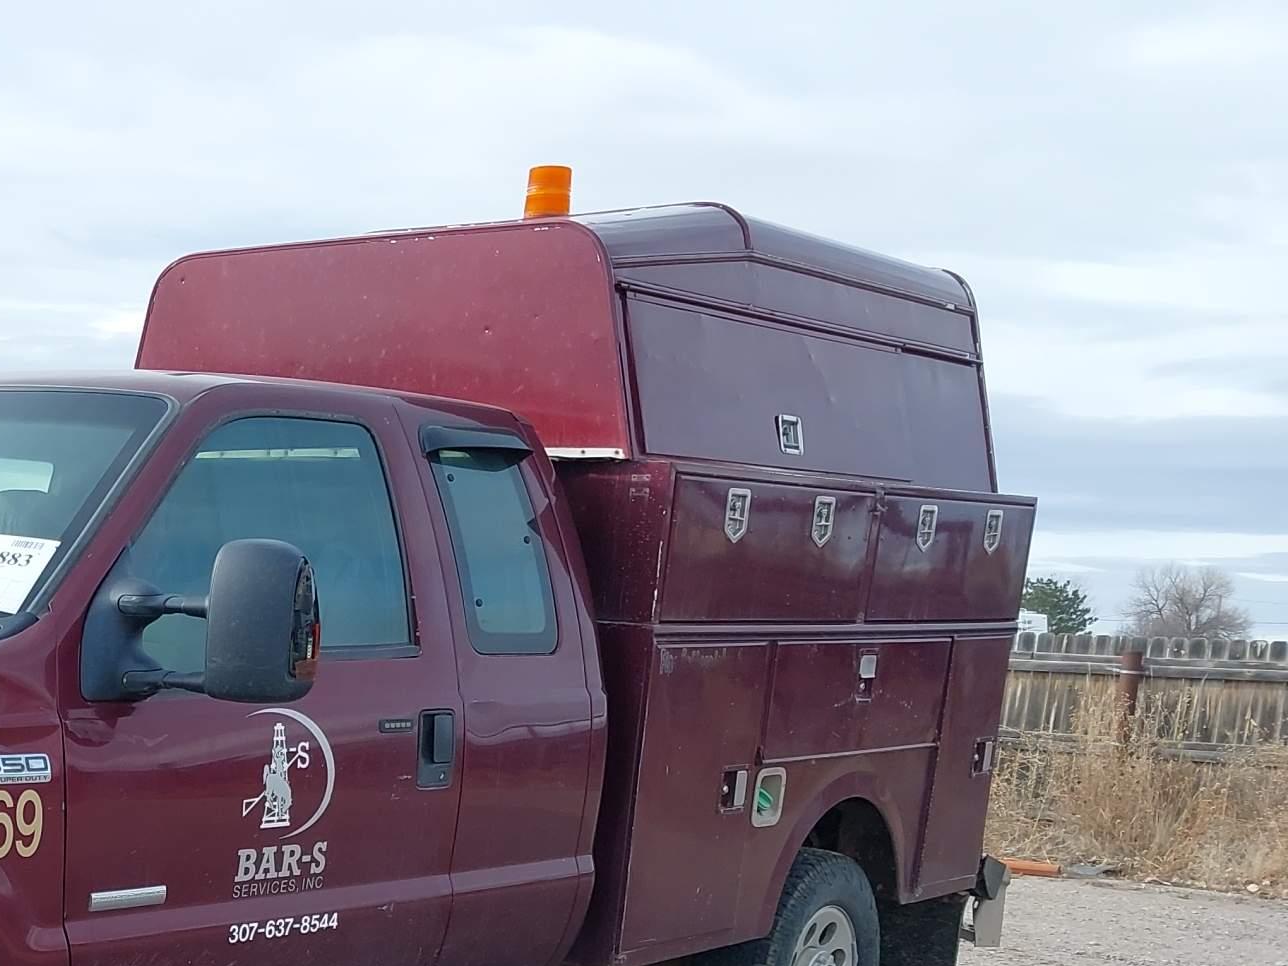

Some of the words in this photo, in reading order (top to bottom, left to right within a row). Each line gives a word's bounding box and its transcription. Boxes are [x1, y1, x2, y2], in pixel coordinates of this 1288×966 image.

[234, 841, 328, 882] BAR-S
[232, 878, 299, 898] SERVICES,
[301, 876, 324, 890] INC
[228, 912, 339, 943] 307-637-8544
